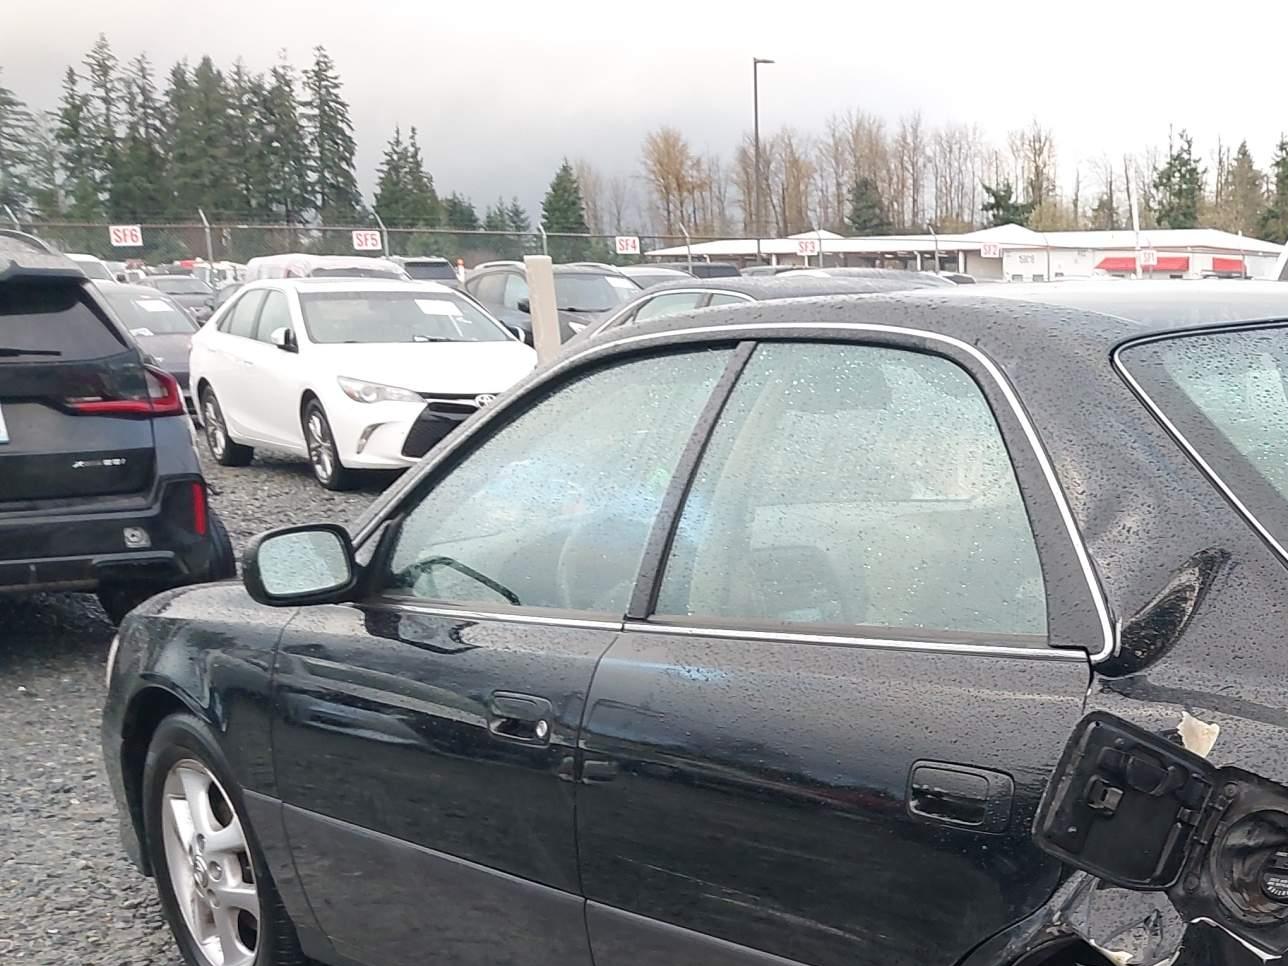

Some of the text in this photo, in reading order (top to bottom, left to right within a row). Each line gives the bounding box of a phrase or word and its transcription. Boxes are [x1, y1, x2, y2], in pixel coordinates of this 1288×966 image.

[112, 227, 140, 244] SF6
[355, 232, 379, 248] SF5
[618, 238, 638, 252] SF4
[799, 239, 816, 253] SF3
